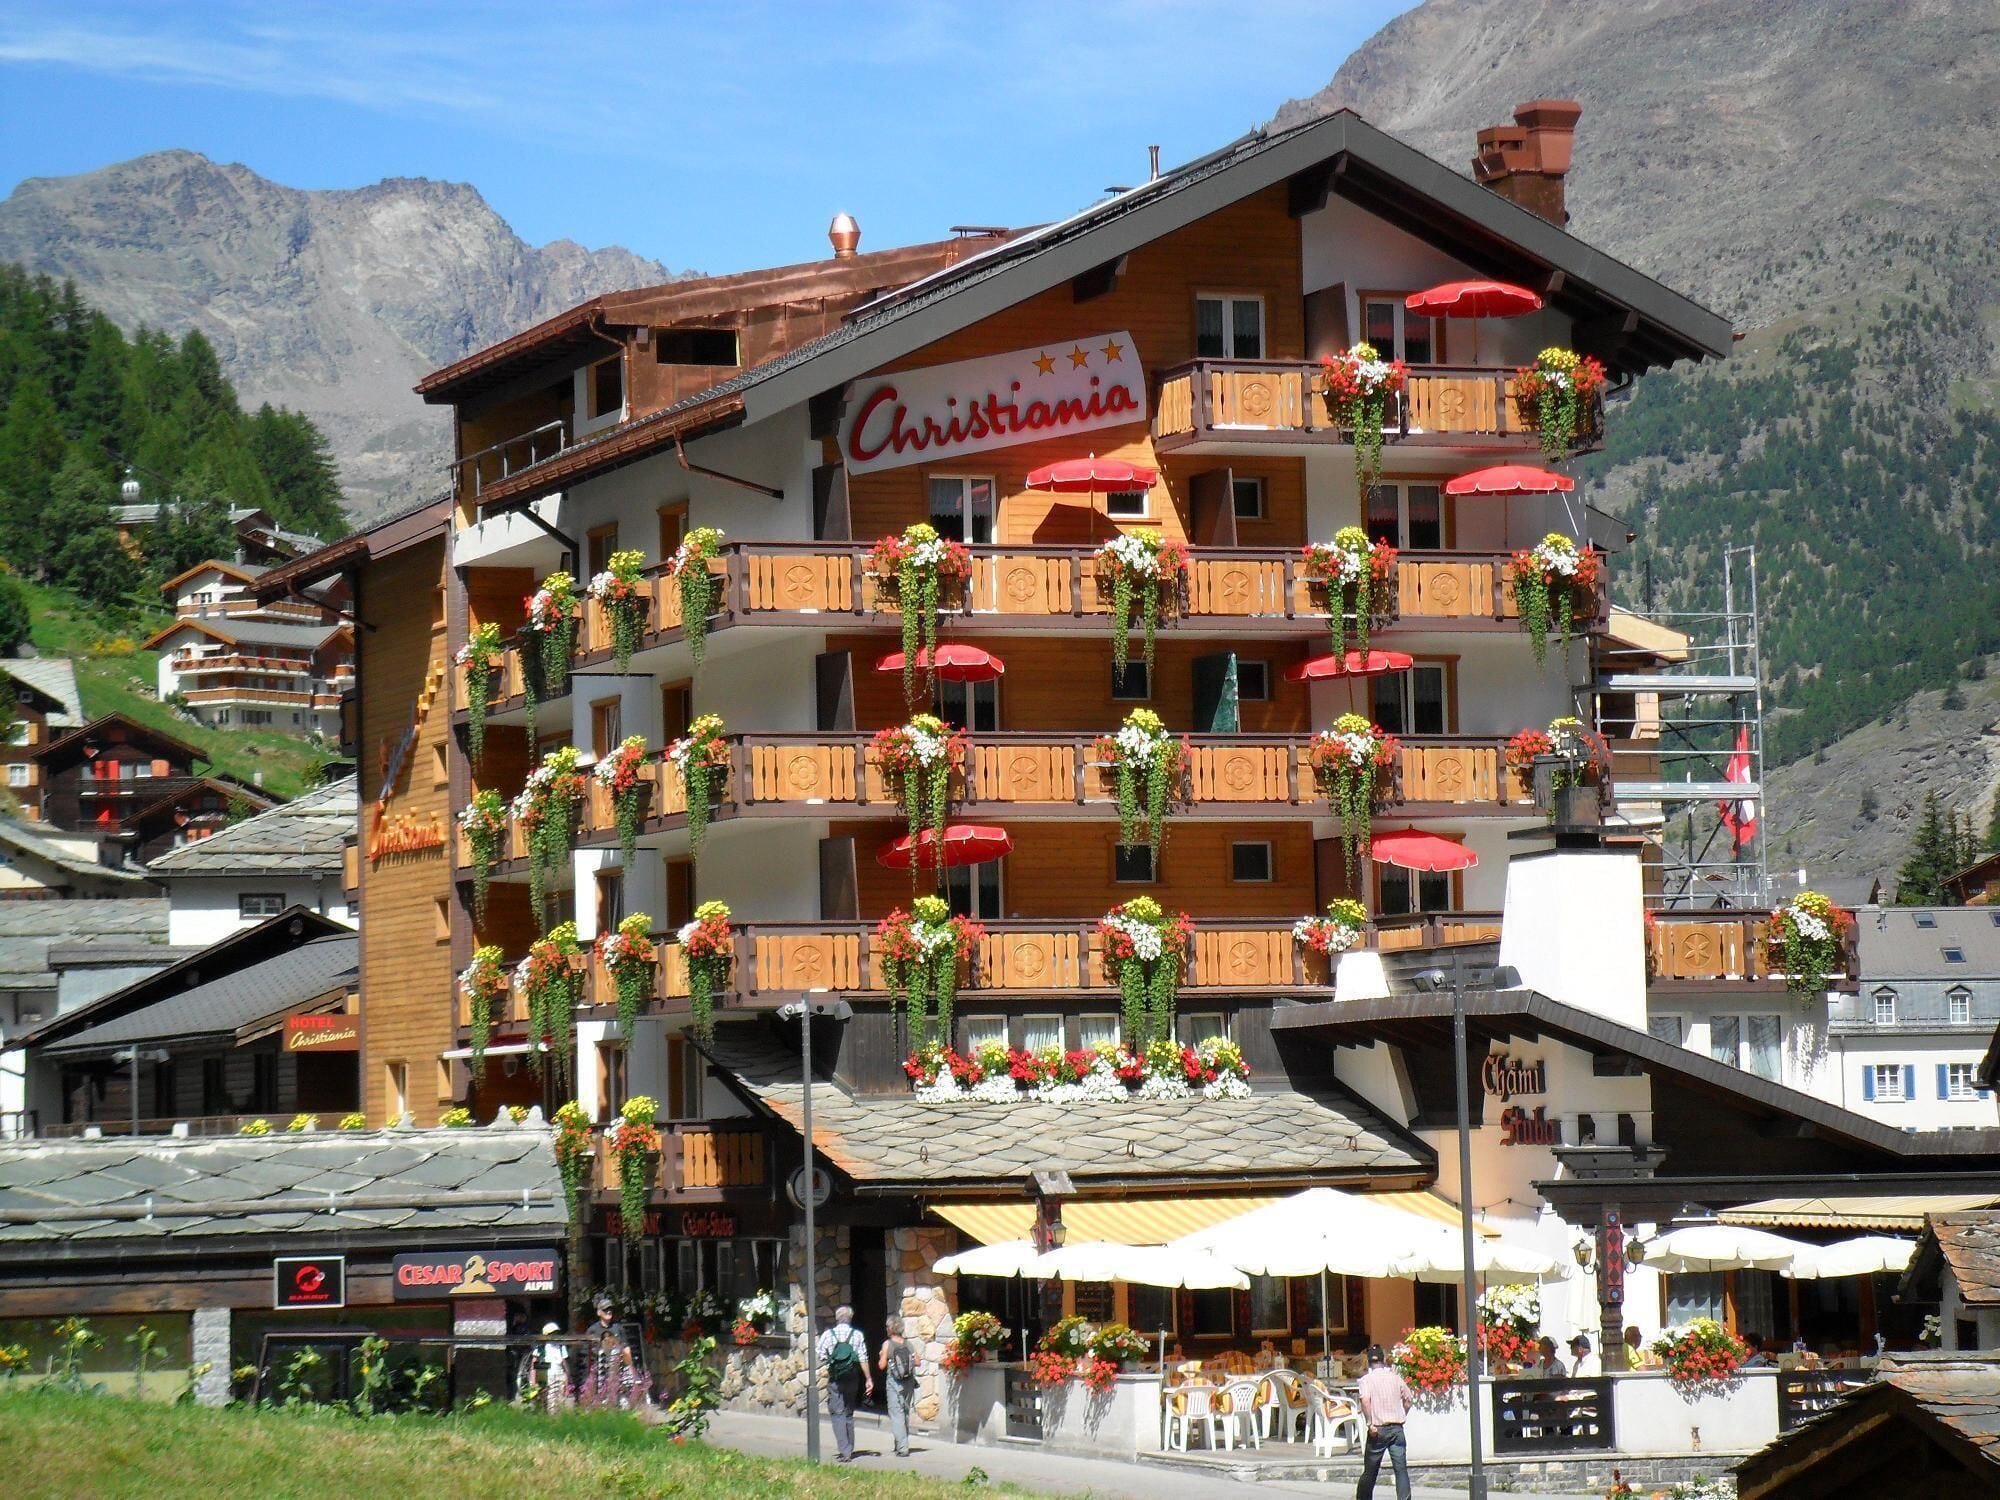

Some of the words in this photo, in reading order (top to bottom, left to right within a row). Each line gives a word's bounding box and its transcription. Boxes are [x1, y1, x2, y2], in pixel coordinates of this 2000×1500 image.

[849, 375, 1139, 461] Christiania
[290, 1017, 336, 1029] HOTEL
[289, 1027, 358, 1050] Christiania
[398, 1263, 462, 1286] CESAR
[487, 1260, 554, 1283] SPORT
[524, 1281, 554, 1291] ALPIN
